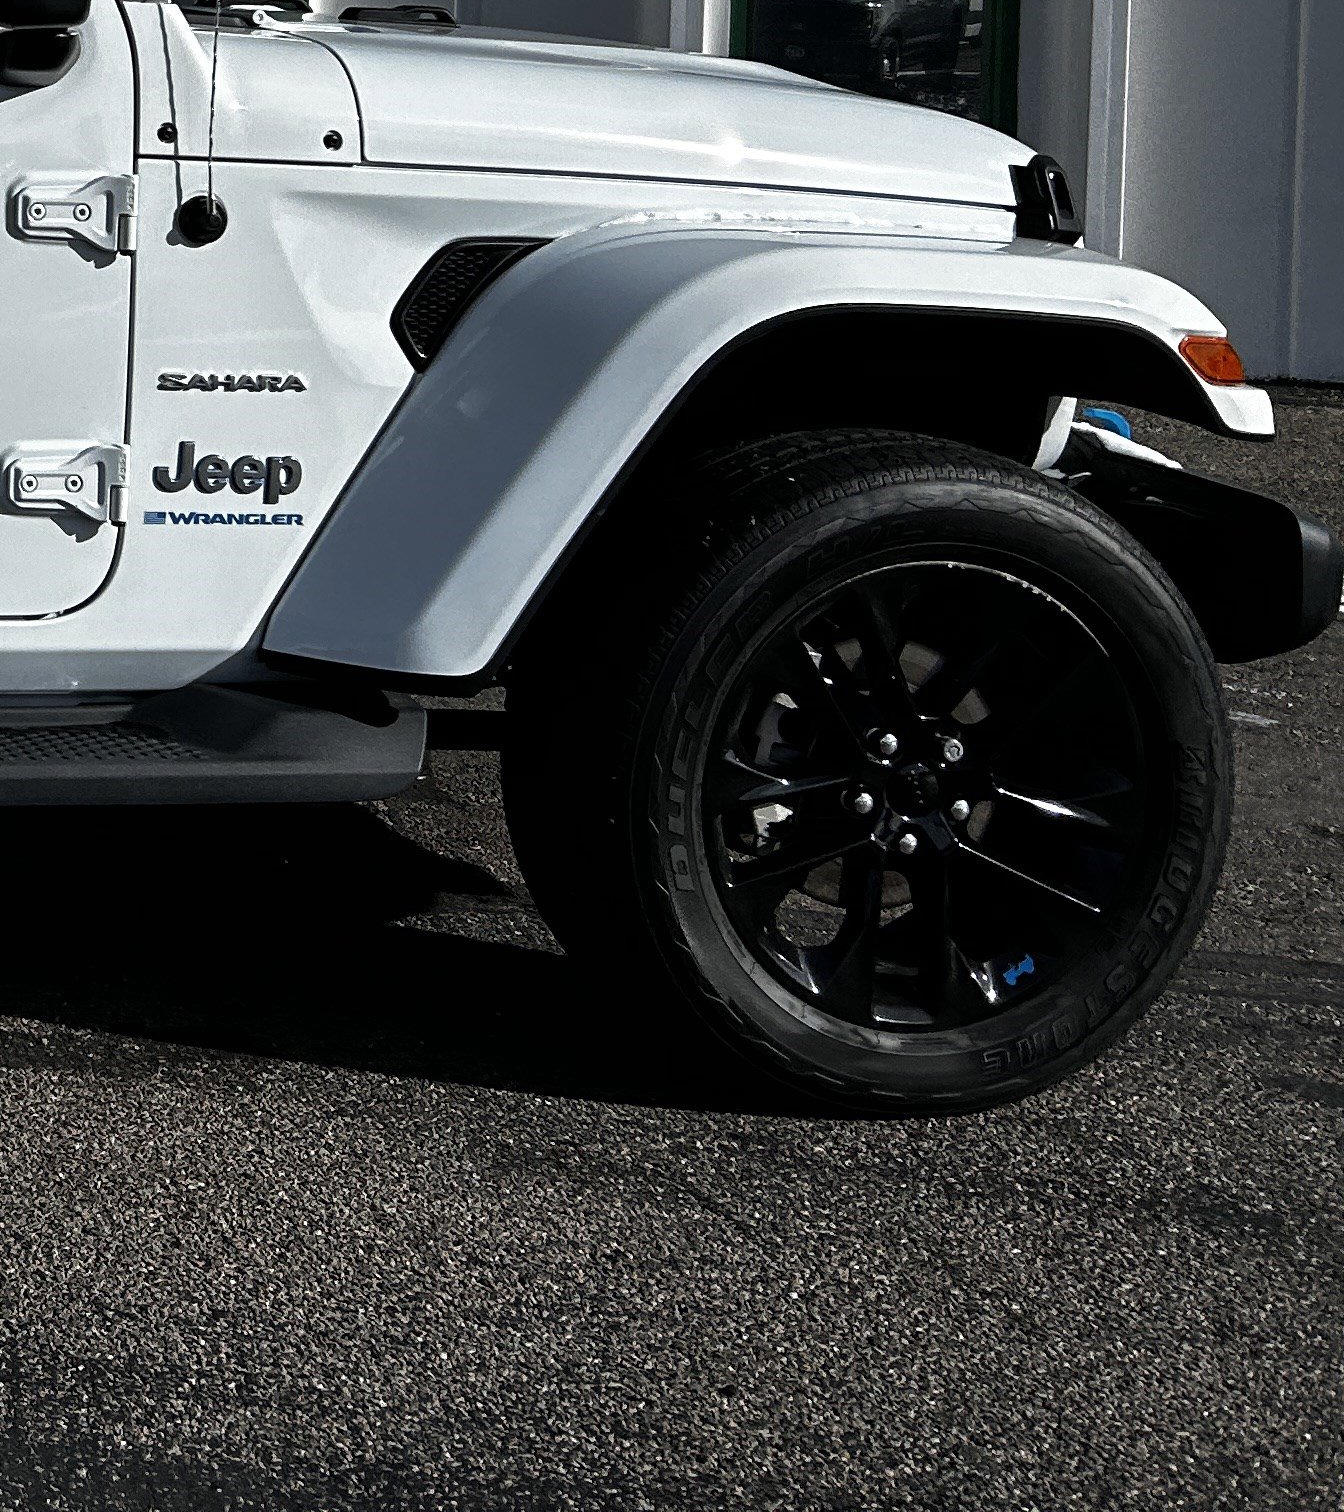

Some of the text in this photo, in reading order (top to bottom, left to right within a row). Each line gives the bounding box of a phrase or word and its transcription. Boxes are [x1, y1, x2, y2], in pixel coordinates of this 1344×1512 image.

[157, 372, 307, 393] SAHARA
[152, 441, 303, 504] Jeep
[168, 511, 305, 526] WRANGLER
[981, 744, 1208, 1078] BRIDGESTONE
